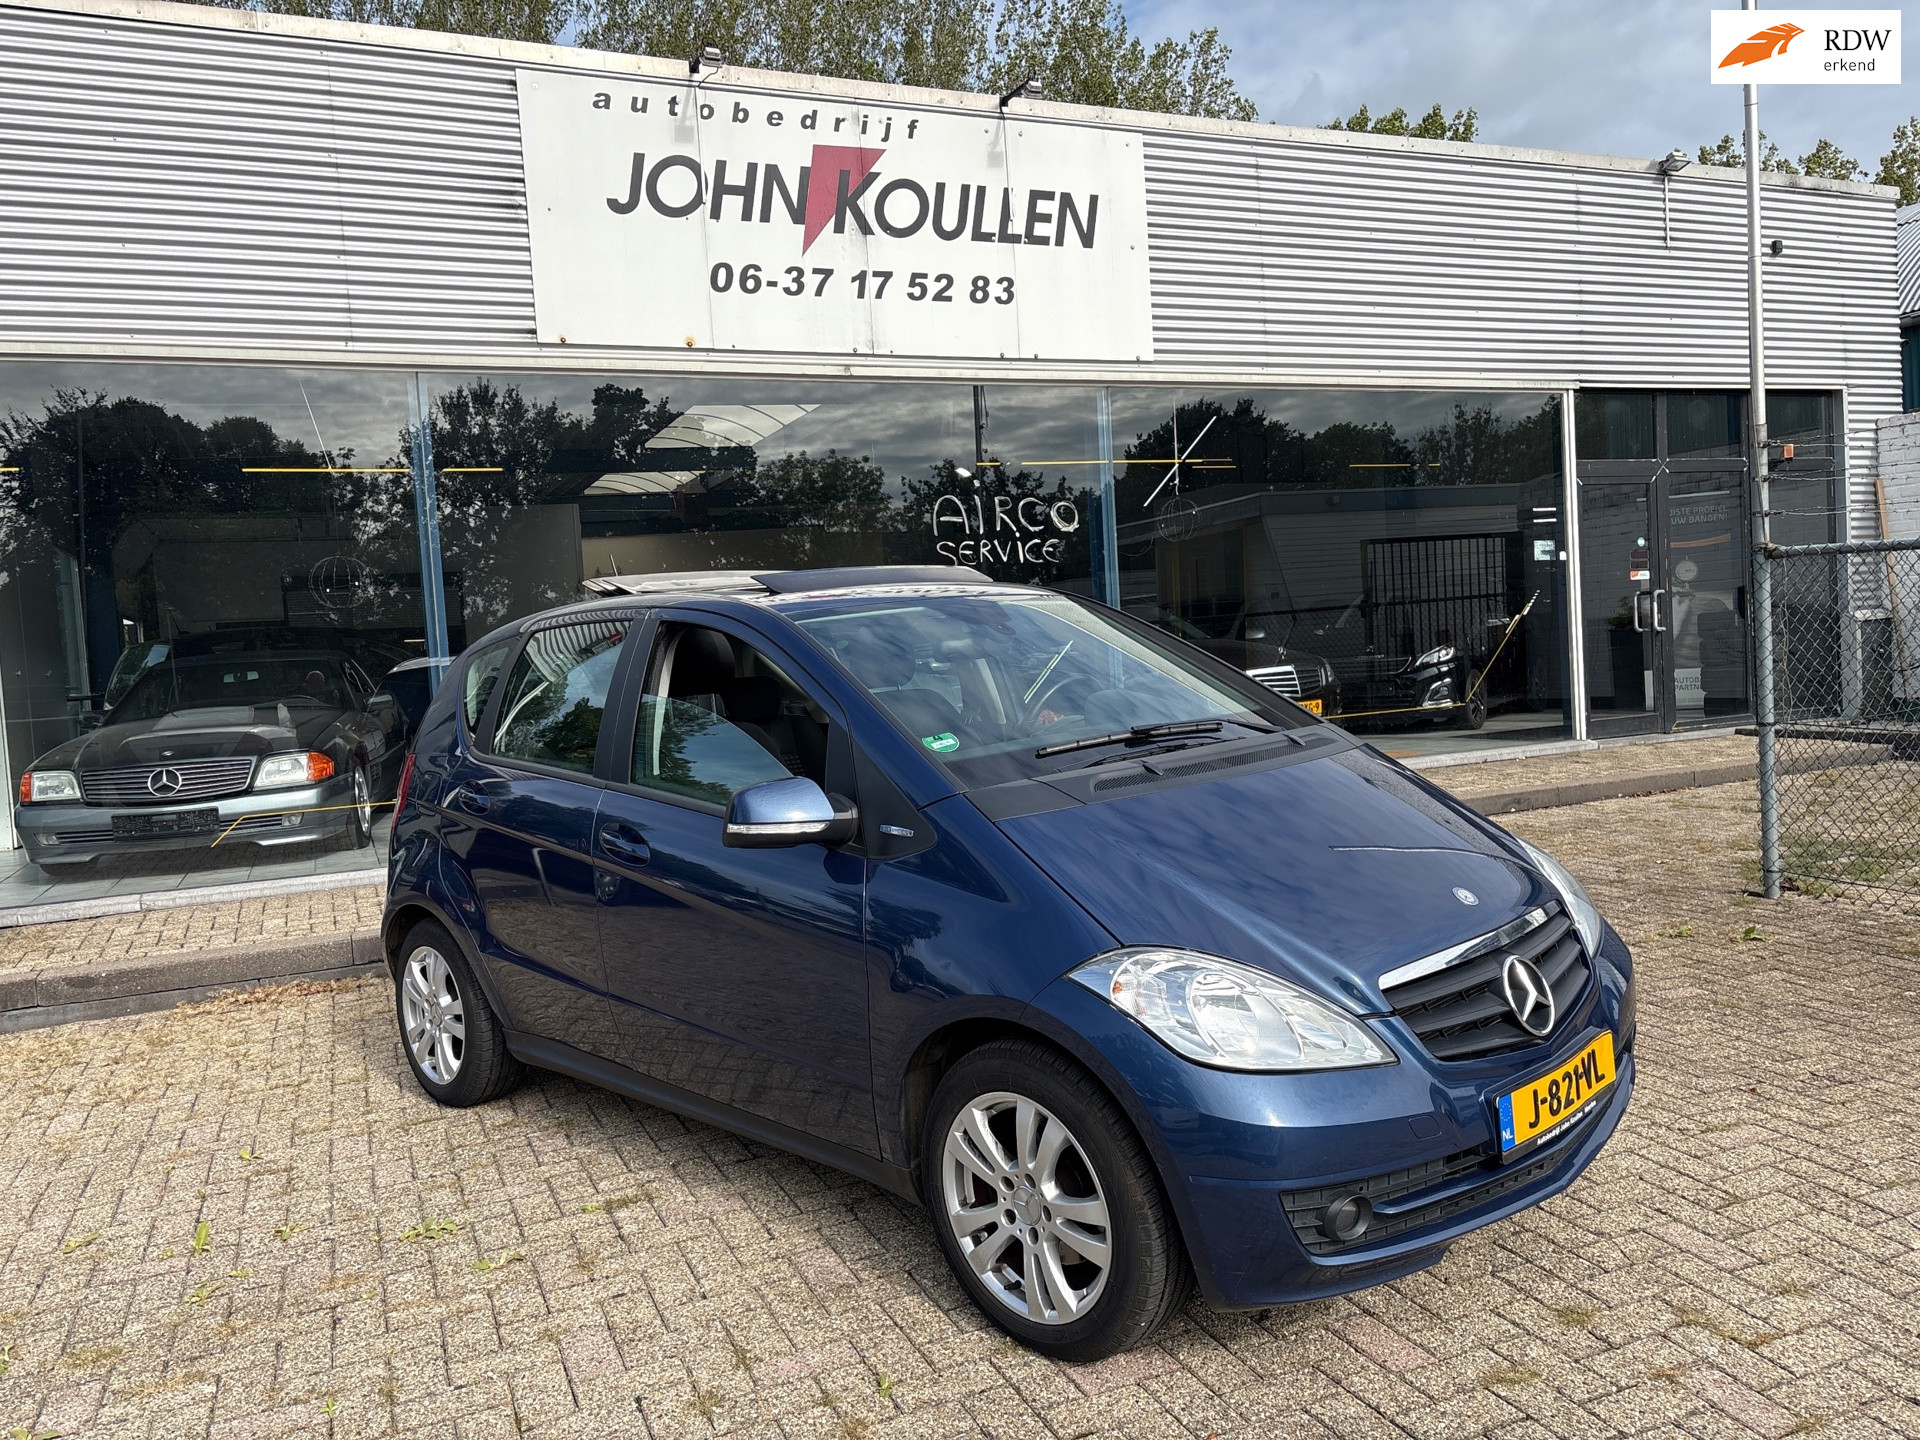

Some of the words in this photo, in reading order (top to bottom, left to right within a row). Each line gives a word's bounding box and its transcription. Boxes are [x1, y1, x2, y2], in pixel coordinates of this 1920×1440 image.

[593, 92, 919, 142] autobedrijf
[607, 152, 812, 225] JOHN
[834, 169, 1099, 249] KOULLEN
[710, 262, 834, 297] 06-37
[851, 270, 894, 300] 17
[907, 273, 954, 302] 52
[970, 276, 1015, 305] 83
[1502, 1128, 1514, 1142] NL
